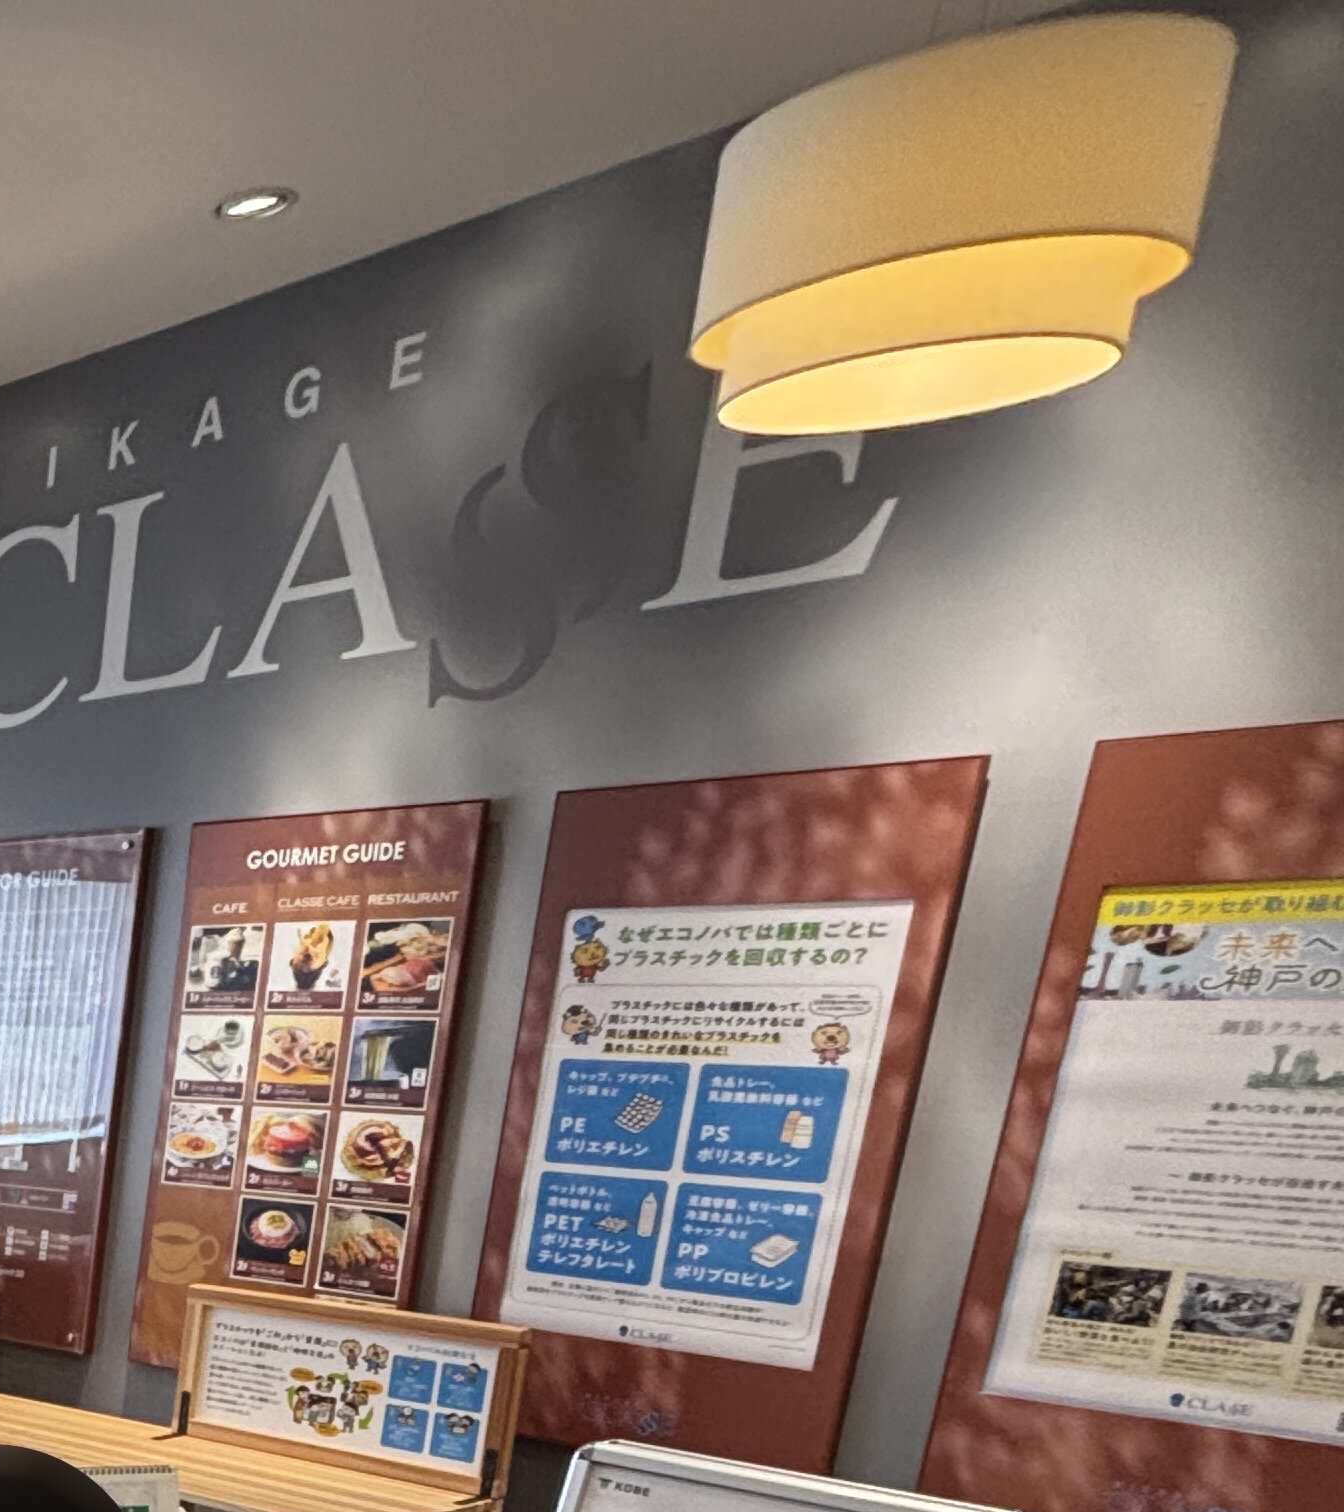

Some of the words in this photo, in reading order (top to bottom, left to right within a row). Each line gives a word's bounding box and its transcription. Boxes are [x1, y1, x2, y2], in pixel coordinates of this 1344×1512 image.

[247, 845, 337, 870] GOURMET
[343, 841, 406, 864] GUIDE
[28, 868, 79, 887] GUIDE
[212, 902, 248, 914] CAFE
[367, 891, 460, 906] RESTAURANT
[617, 921, 889, 943] なぜエコノバでは種類ごとに
[1217, 931, 1339, 960] 未来へ
[613, 948, 868, 967] プラスチックを回収するの?
[560, 1116, 586, 1133] PE
[700, 1124, 731, 1142] PS
[556, 1138, 650, 1157] ポリエチレン
[696, 1148, 801, 1168] ポリスチレン
[544, 1214, 584, 1230] PET
[541, 1233, 632, 1253] ポリエチレン
[677, 1242, 709, 1260] PP
[537, 1250, 636, 1274] テレフタレート
[674, 1265, 793, 1290] ポリプロピレン
[615, 1482, 650, 1497] KOBE
